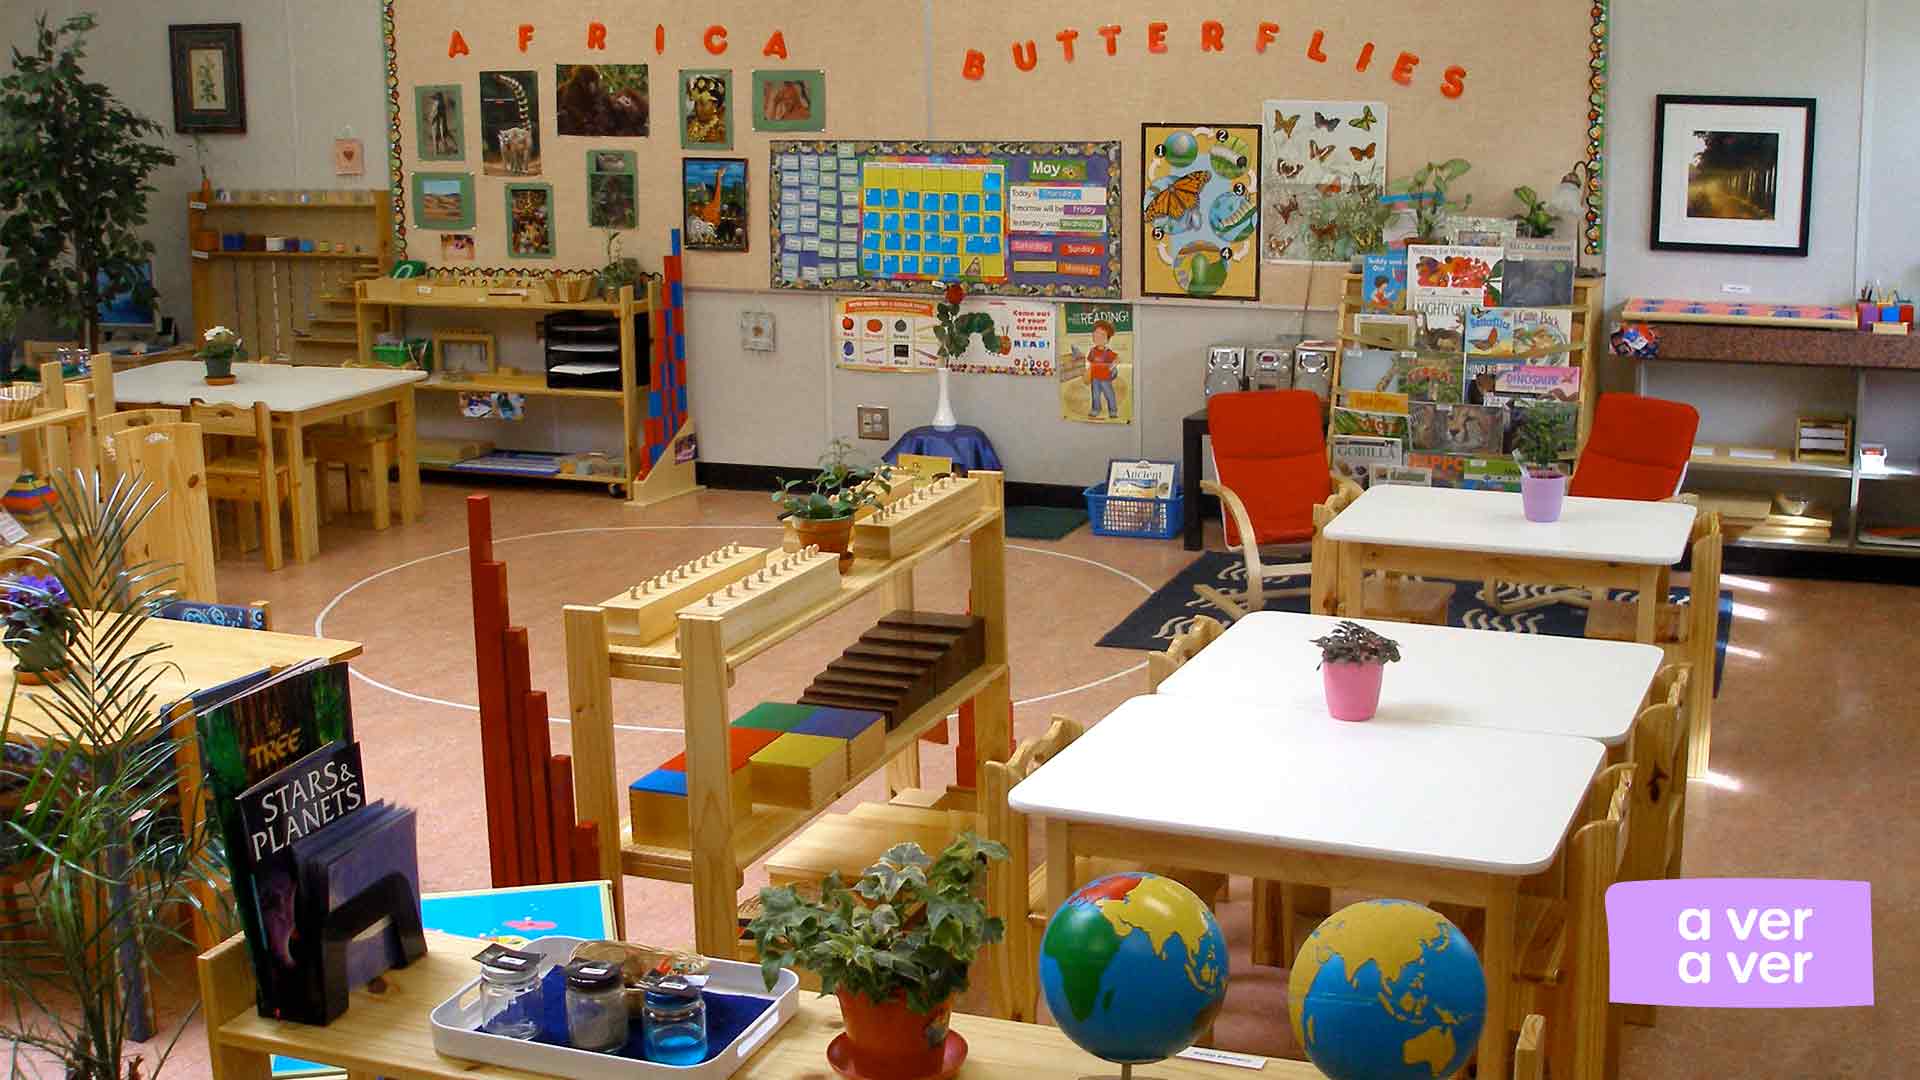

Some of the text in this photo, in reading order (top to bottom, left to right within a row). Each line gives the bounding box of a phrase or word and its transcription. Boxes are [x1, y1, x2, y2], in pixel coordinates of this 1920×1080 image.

[448, 23, 788, 60] AFRICA
[962, 20, 1467, 99] BUTTERFLIES
[1032, 160, 1060, 177] May
[1073, 204, 1097, 215] Friday
[1067, 244, 1096, 255] Sunday
[1080, 310, 1129, 326] READING!
[1014, 340, 1051, 349] READ!
[1123, 468, 1163, 480] Ancient
[248, 727, 303, 769] TREE
[262, 760, 339, 824] STARS
[251, 782, 362, 863] PLANETS
